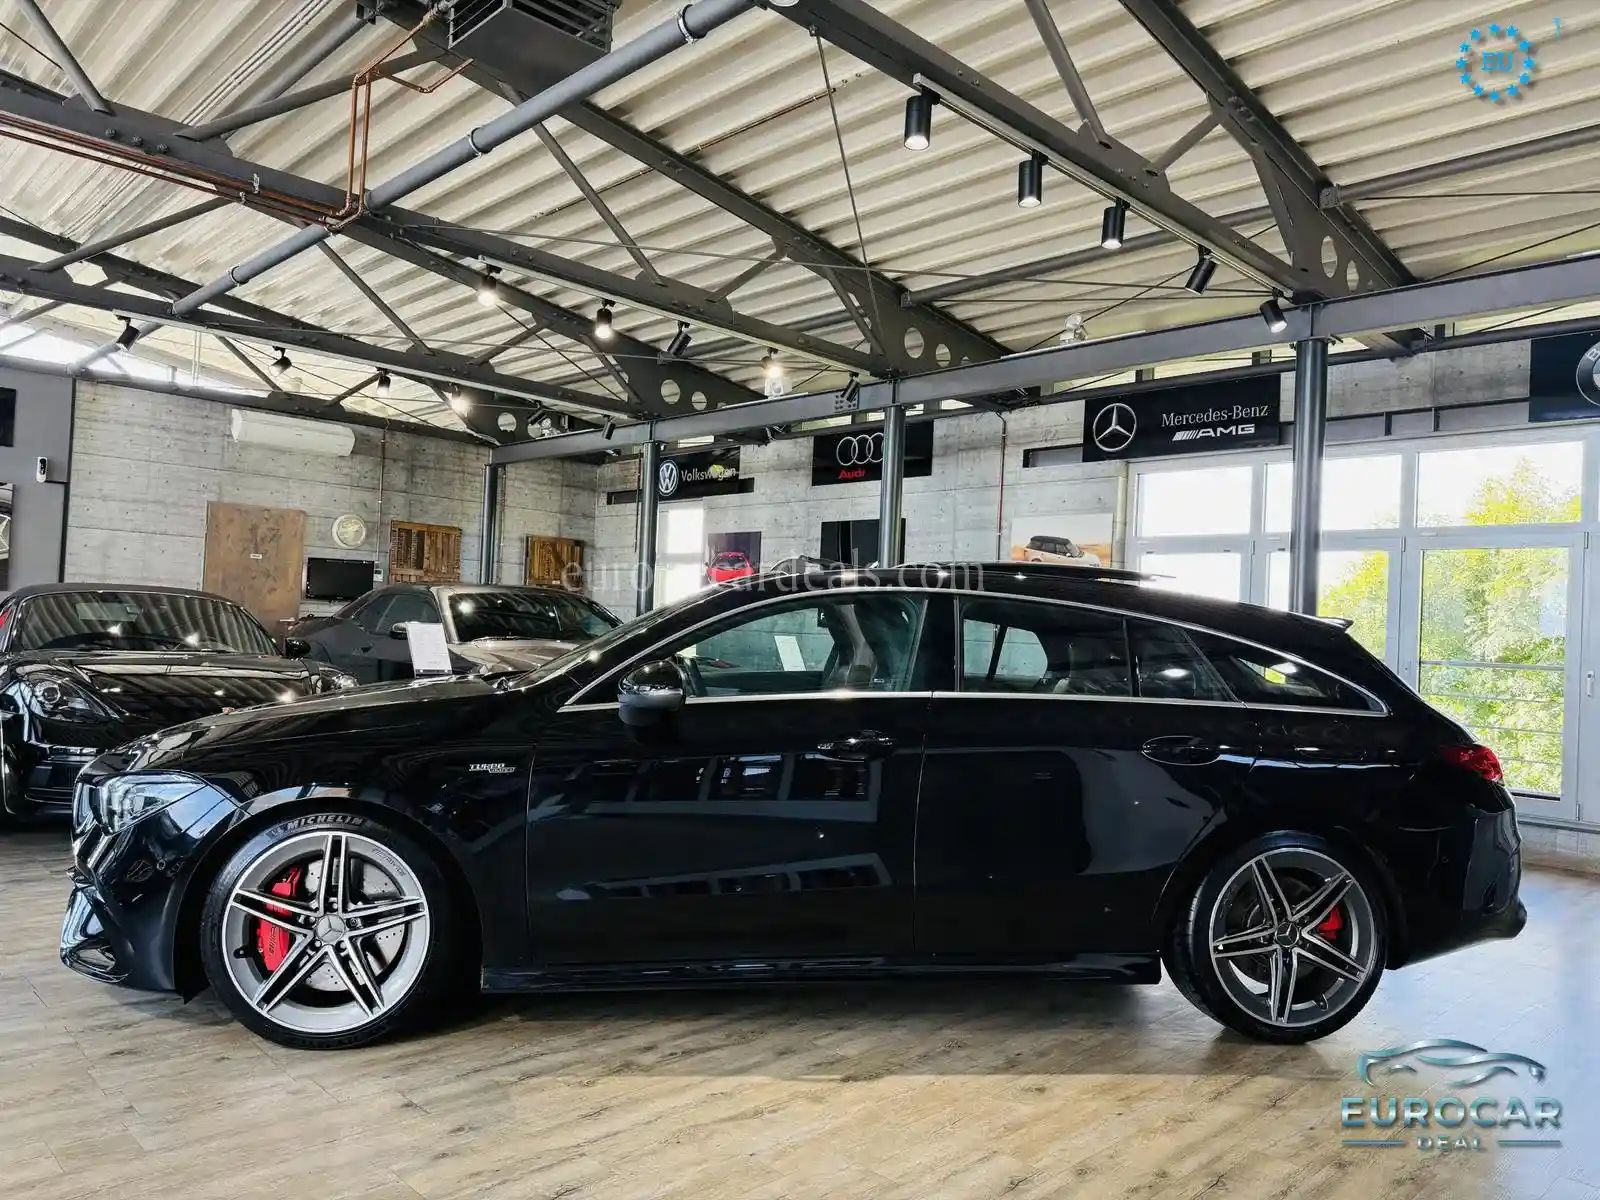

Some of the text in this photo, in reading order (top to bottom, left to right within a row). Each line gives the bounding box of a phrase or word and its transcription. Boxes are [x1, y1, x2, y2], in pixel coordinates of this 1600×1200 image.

[1161, 404, 1269, 428] Mercedes-Benz
[838, 468, 866, 480] Audi
[286, 814, 363, 832] MICHELIN
